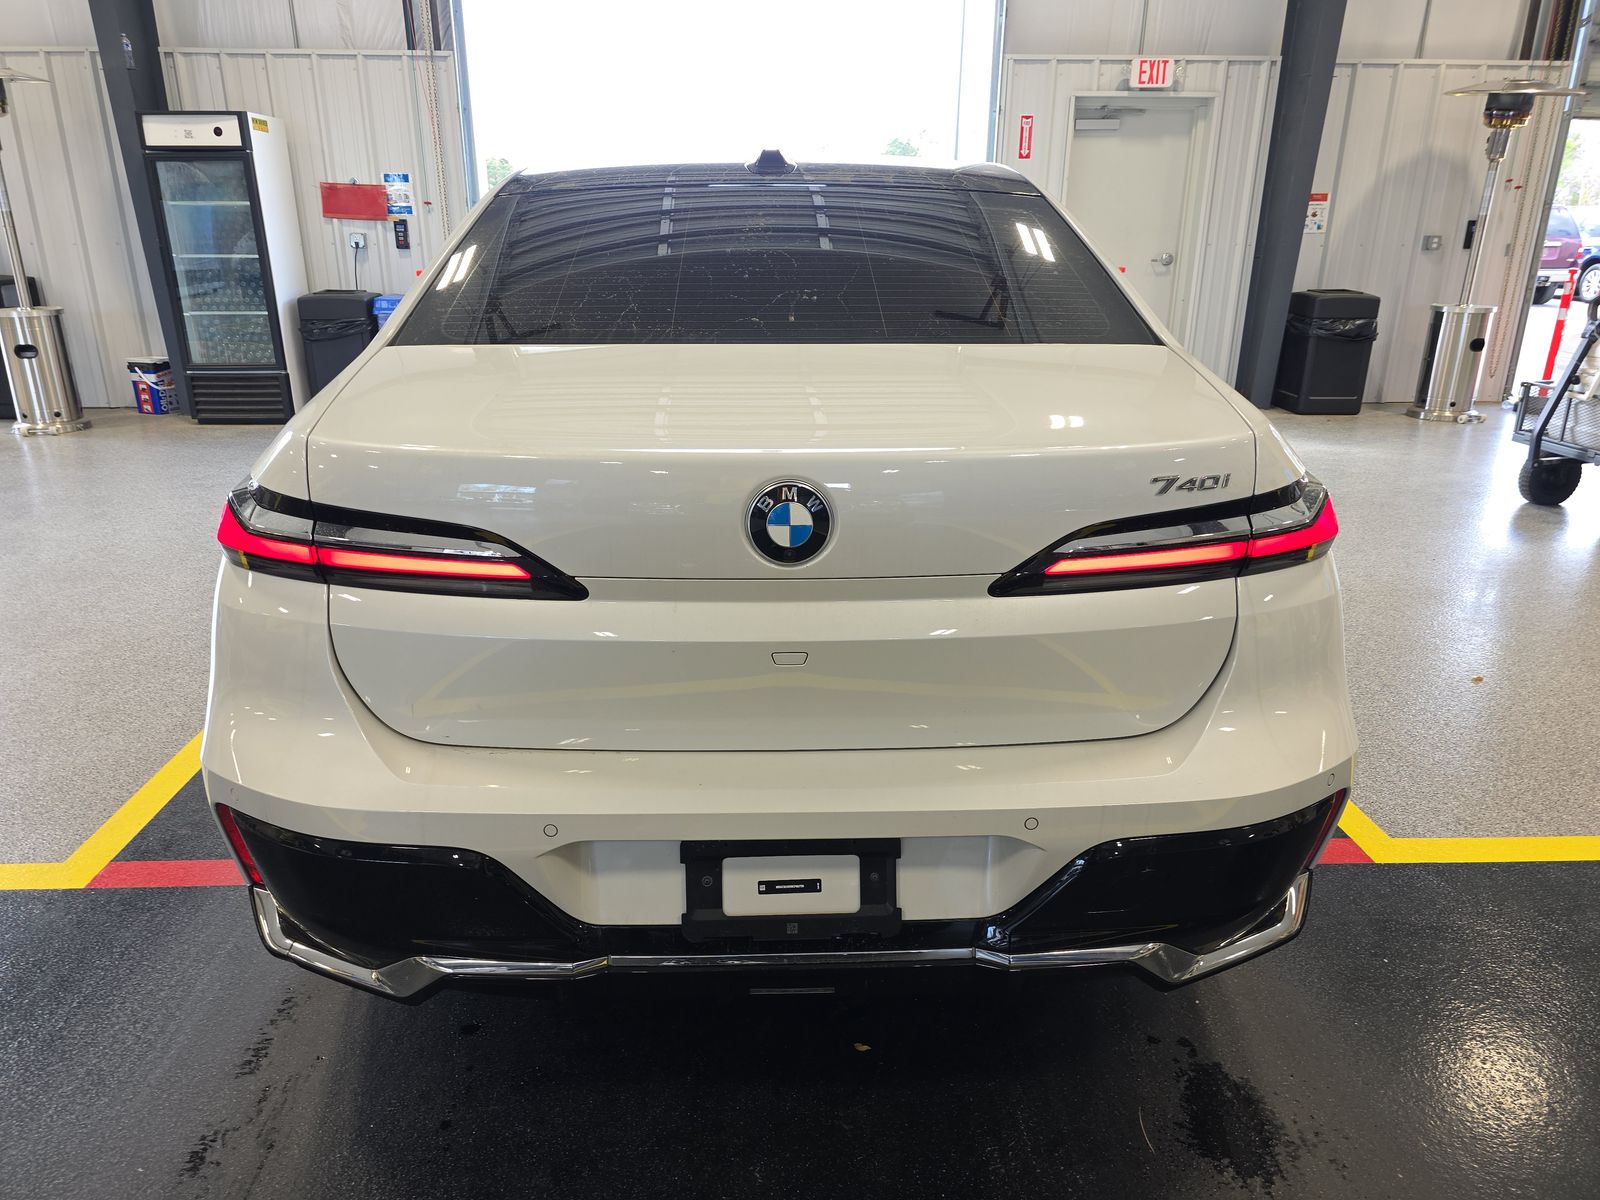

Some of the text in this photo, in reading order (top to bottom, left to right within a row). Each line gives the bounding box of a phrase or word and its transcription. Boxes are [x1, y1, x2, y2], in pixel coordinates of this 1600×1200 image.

[1138, 60, 1169, 85] EXIT
[1150, 473, 1231, 496] 740i
[757, 486, 823, 513] BMW
